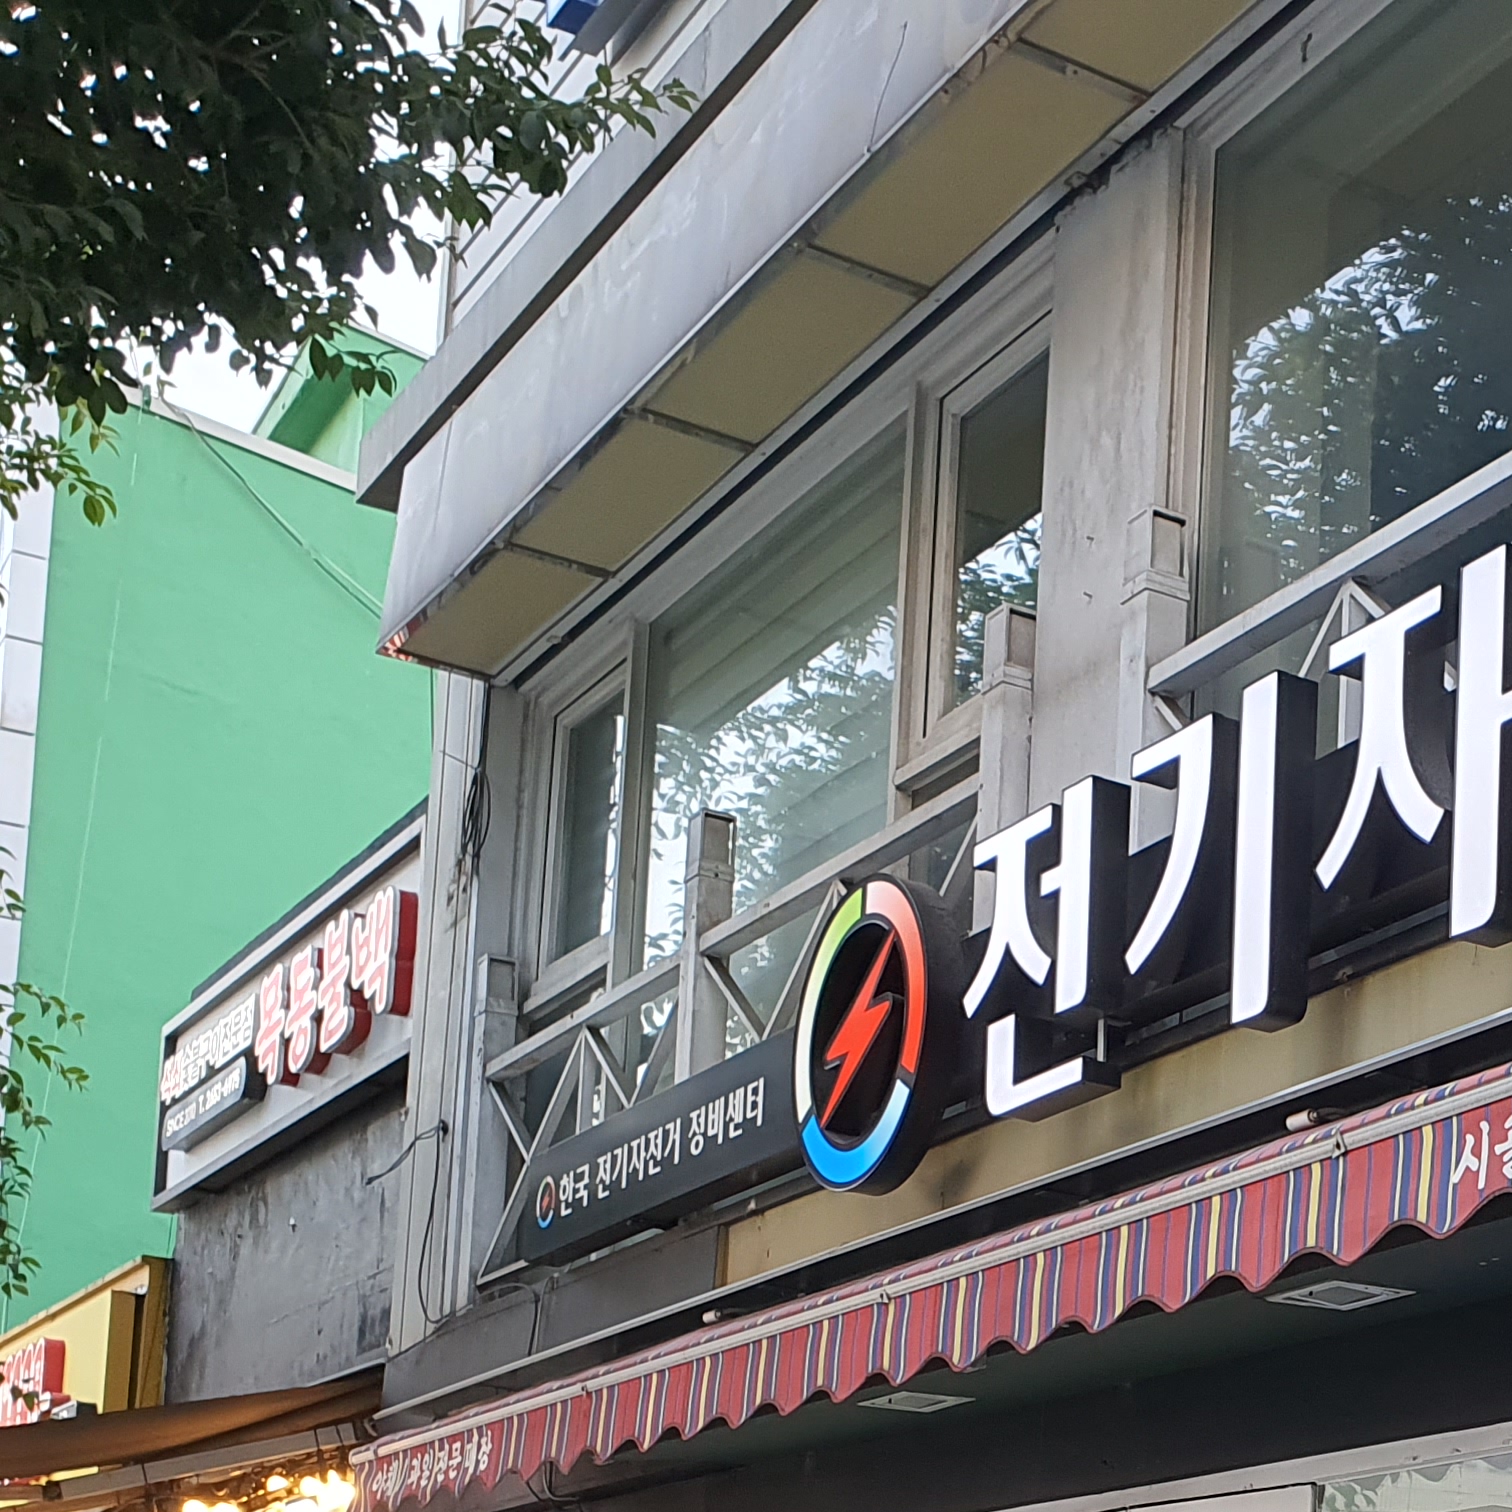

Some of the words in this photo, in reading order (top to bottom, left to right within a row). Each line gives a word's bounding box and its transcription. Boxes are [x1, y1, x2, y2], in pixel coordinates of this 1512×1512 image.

[255, 885, 398, 1086] 목동불백
[558, 1163, 590, 1218] 한국
[595, 1117, 682, 1200] 전기자전거
[688, 1076, 765, 1157] 정비센터
